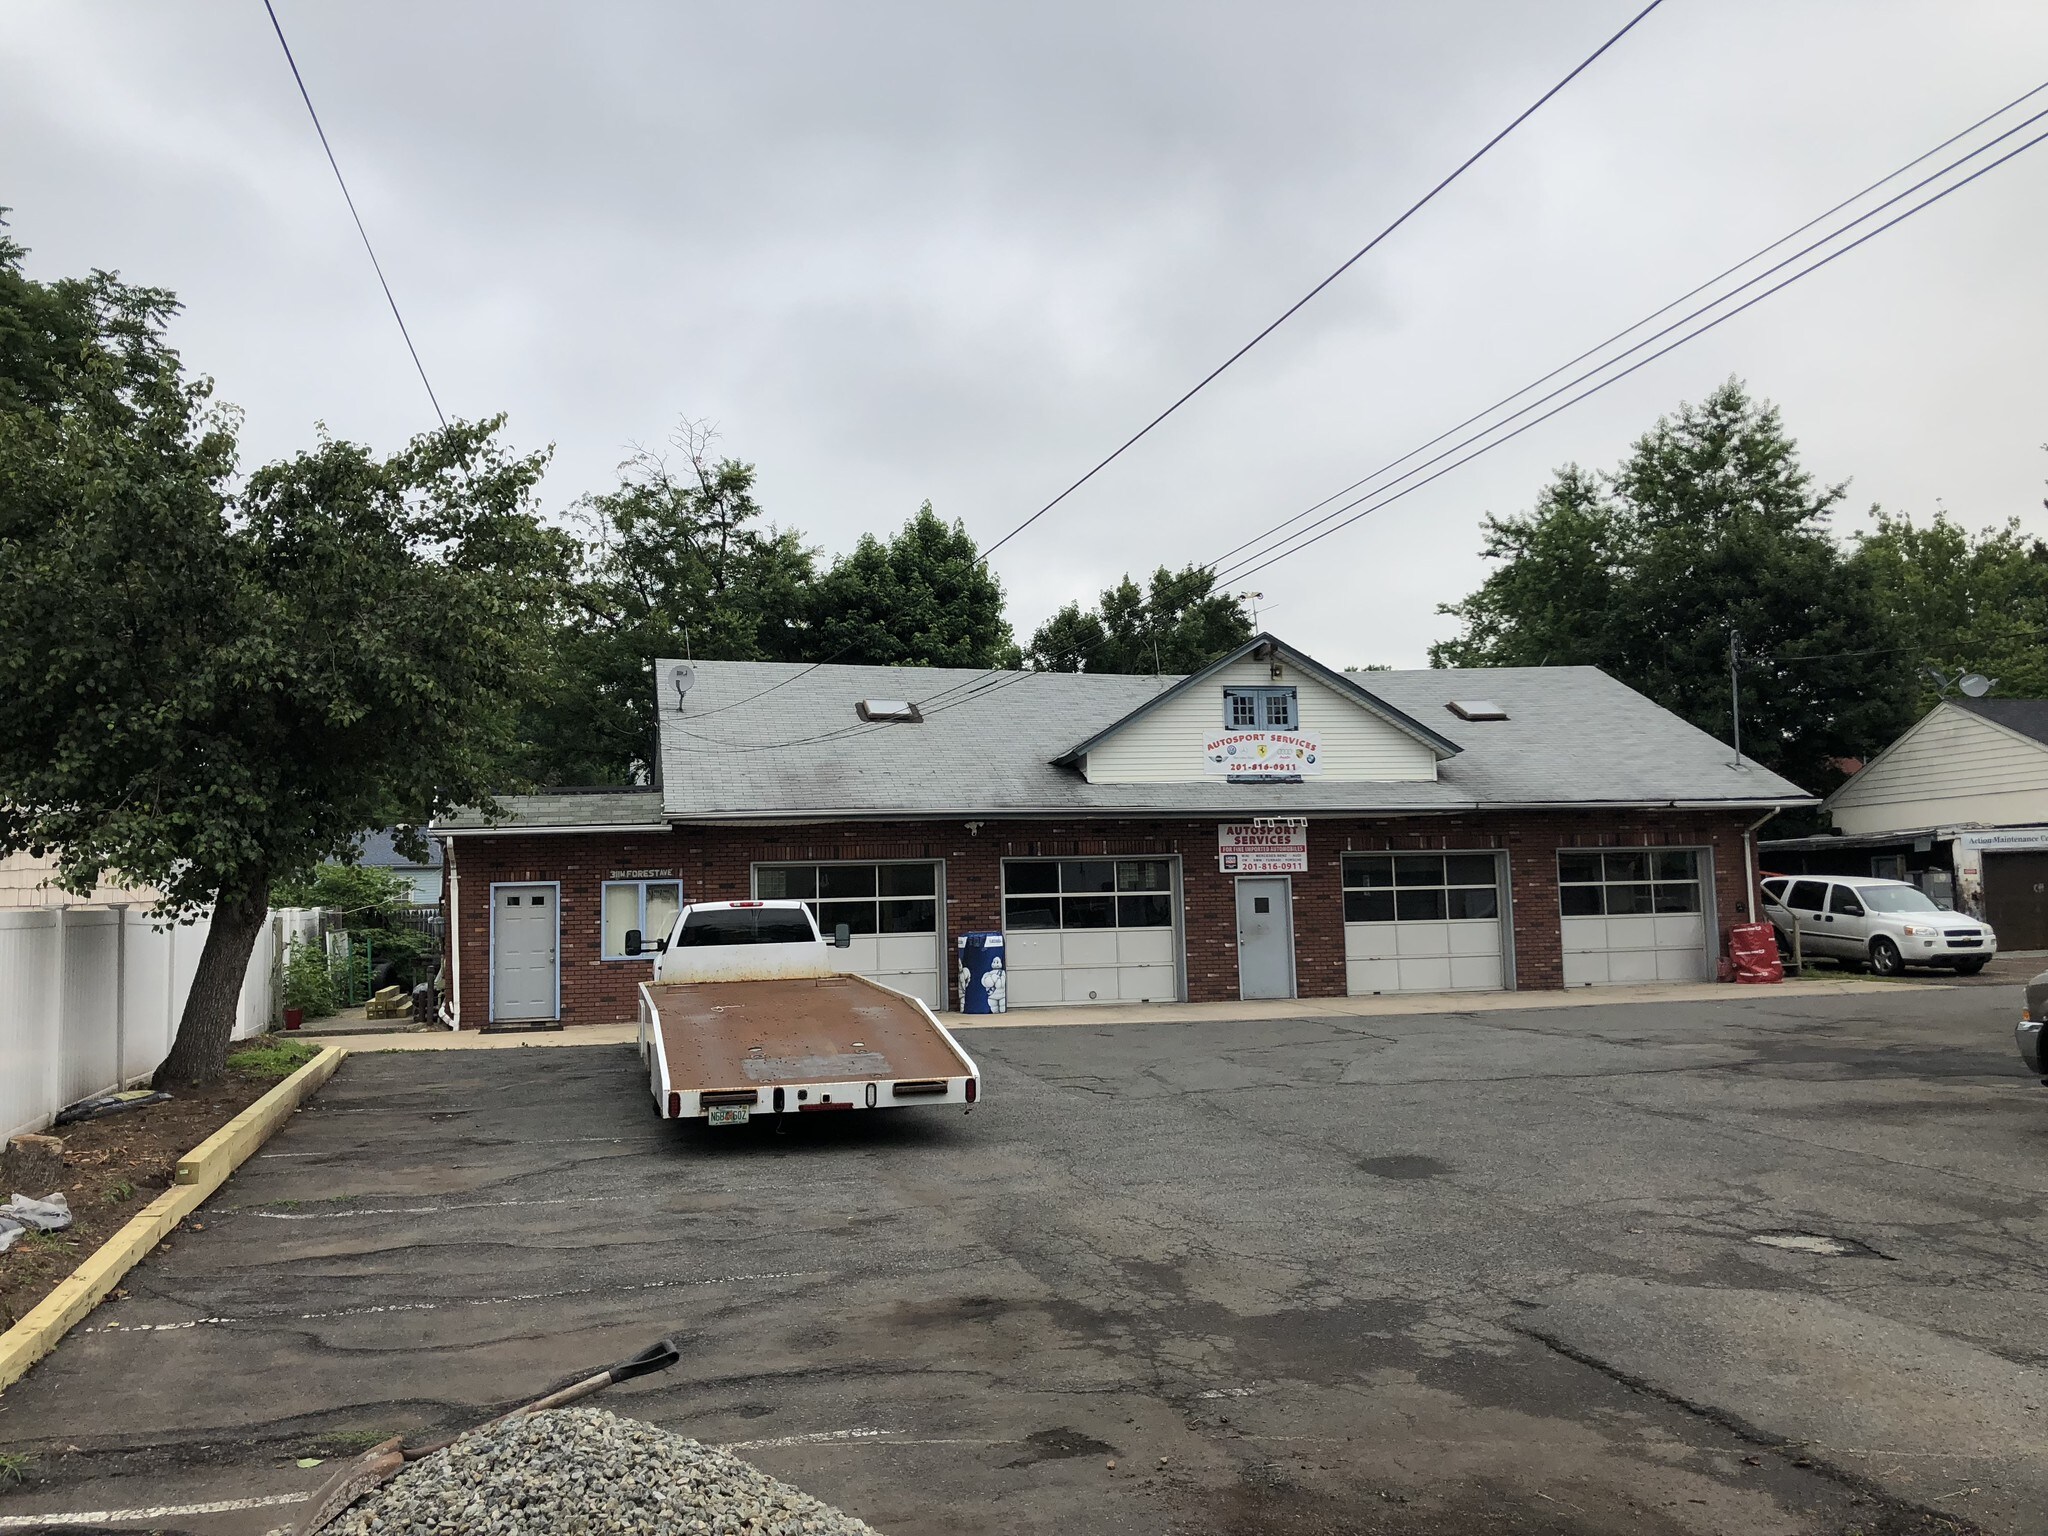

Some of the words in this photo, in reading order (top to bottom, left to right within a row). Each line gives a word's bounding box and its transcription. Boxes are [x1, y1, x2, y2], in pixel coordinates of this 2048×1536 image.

[1207, 733, 1266, 751] AUTOSPORT
[1271, 734, 1317, 752] SERVICES
[1230, 763, 1297, 771] 201-816-0911
[1226, 826, 1298, 835] AUTOSPORT
[1234, 836, 1291, 845] SERVICES
[1993, 836, 2039, 844] Maintenance
[1270, 845, 1304, 853] AUTOMOBILES
[626, 869, 659, 878] FOREST
[660, 868, 673, 876] AVE
